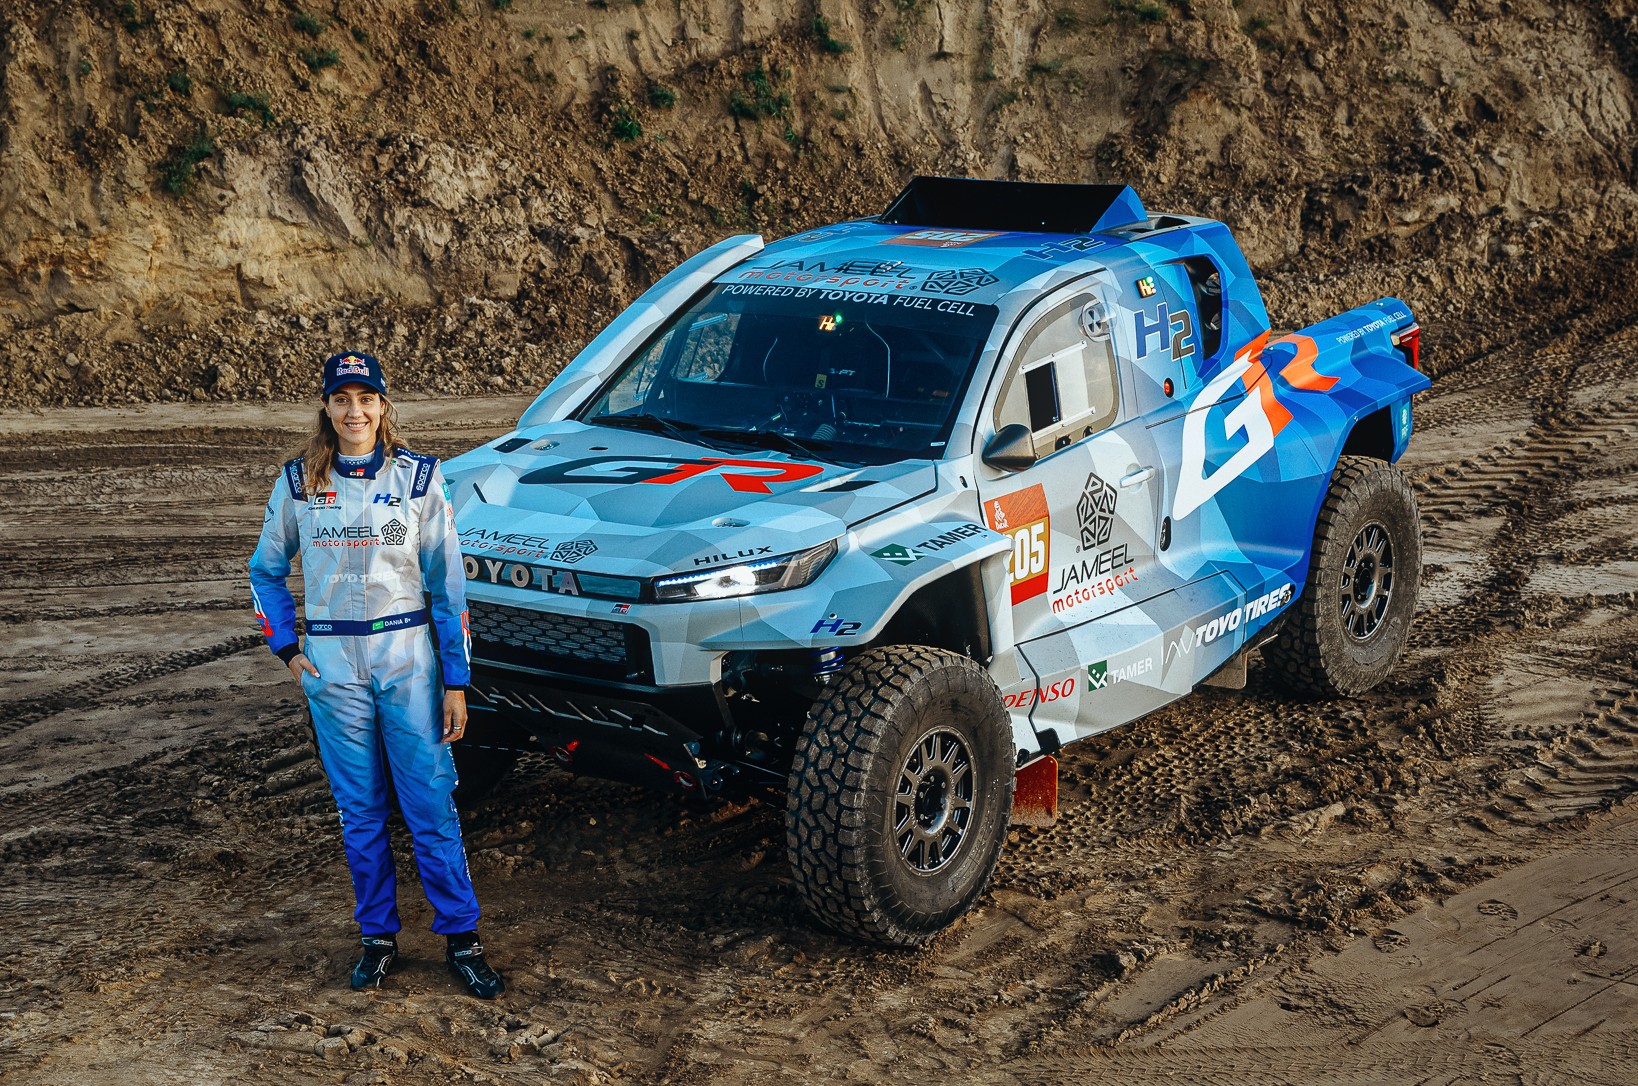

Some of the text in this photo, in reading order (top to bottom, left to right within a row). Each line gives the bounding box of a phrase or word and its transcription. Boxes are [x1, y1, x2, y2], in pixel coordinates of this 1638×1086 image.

[738, 271, 910, 290] motorsport
[752, 259, 917, 280] JAMEEL
[721, 284, 975, 317] POWERED BY TOYOTA FUEL CELL
[1133, 301, 1196, 362] H2
[1363, 319, 1386, 333] TOYOTA
[1394, 310, 1407, 321] CELL
[336, 365, 370, 377] Red Bull
[349, 469, 364, 477] GR
[415, 463, 431, 492] sparco
[518, 455, 825, 494] GR
[314, 496, 336, 504] GR
[373, 493, 402, 508] H2
[312, 526, 379, 539] JAMEEL
[312, 538, 380, 549] motorsport
[457, 527, 550, 550] JAMEEL
[915, 523, 988, 552] TAMER
[459, 538, 545, 559] otorsport
[693, 545, 774, 566] HILUX
[463, 555, 579, 596] OYOTA
[1053, 543, 1135, 594] JAMEEL
[1052, 567, 1139, 614] motorsport
[384, 618, 403, 628] DANIA
[1195, 607, 1242, 648] TOYO
[1243, 582, 1292, 624] TIRES
[810, 618, 862, 636] H2
[1110, 658, 1153, 685] TAMER
[1003, 677, 1075, 709] DENSO
